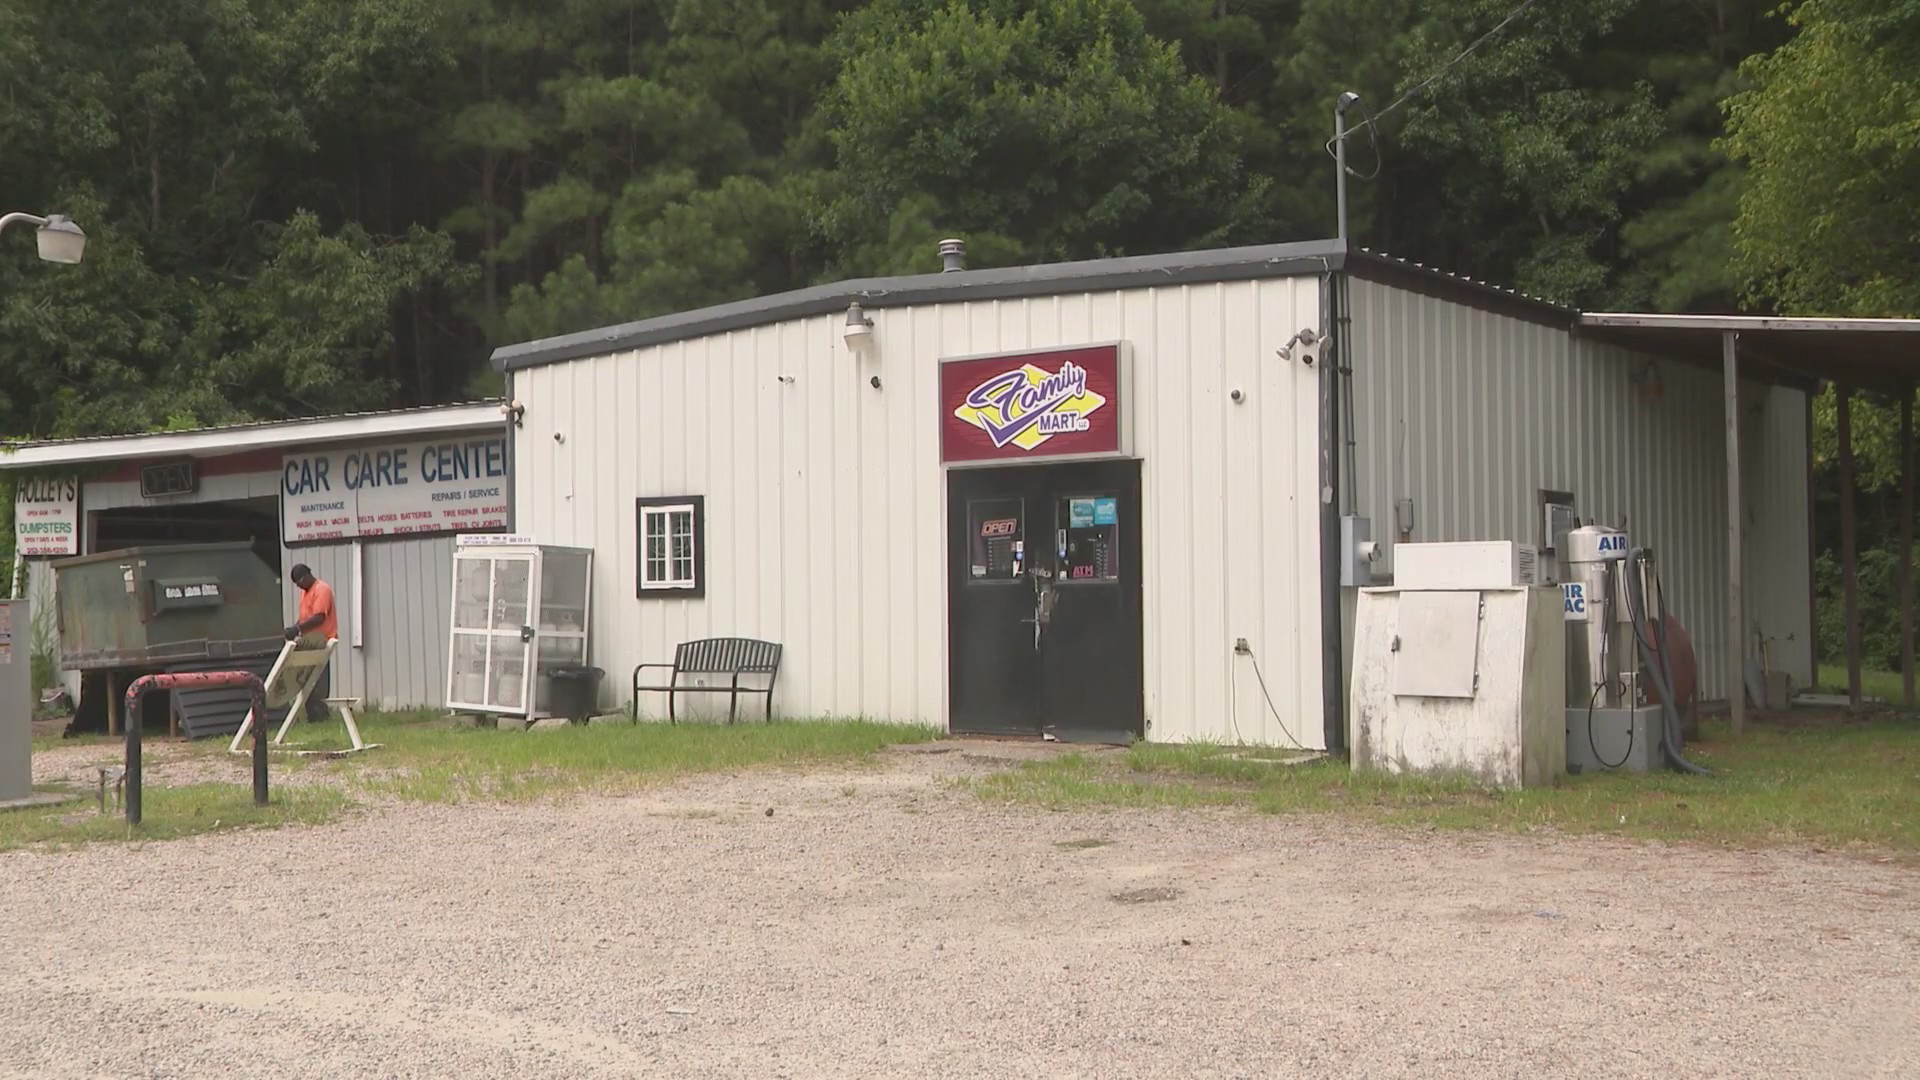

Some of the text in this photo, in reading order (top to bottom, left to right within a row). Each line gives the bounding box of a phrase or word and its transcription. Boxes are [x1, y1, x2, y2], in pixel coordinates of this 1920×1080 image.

[967, 361, 1085, 422] Family
[1039, 413, 1077, 431] MART
[285, 456, 330, 496] CAR
[344, 448, 408, 491] CARE
[17, 478, 75, 503] HOLLEY'S
[431, 491, 461, 502] REPAIRS
[468, 487, 500, 499] SERVICE
[301, 501, 345, 513] MAINTENANCE
[443, 508, 457, 518] TIRE
[457, 507, 478, 517] REPAIR
[378, 513, 398, 522] HOSES
[400, 510, 433, 521] BATTERIES
[19, 522, 72, 534] DUMPSTERS
[296, 519, 312, 529] WASH
[314, 518, 328, 528] WAX
[481, 518, 502, 529] JOINTS
[982, 521, 1014, 534] OPEN
[316, 529, 343, 540] SERVICES
[1598, 536, 1626, 550] AIR
[1072, 565, 1094, 578] ATM
